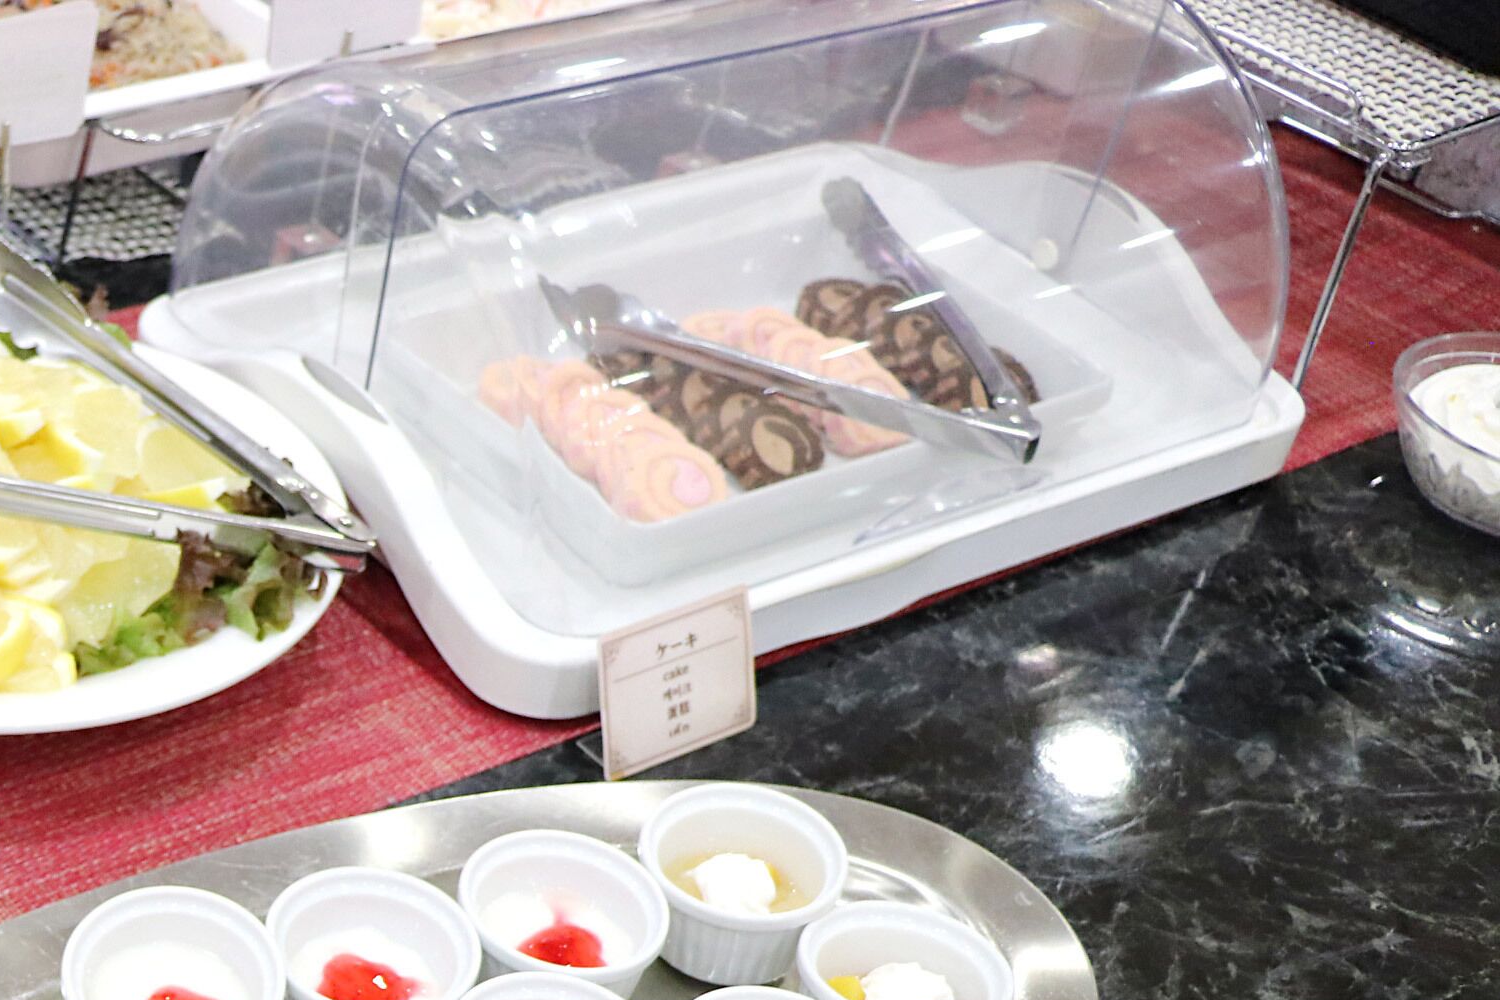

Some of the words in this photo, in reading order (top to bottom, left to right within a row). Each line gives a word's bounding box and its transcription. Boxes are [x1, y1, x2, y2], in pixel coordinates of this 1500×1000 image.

[656, 632, 697, 660] ケーキ
[663, 664, 690, 681] cake
